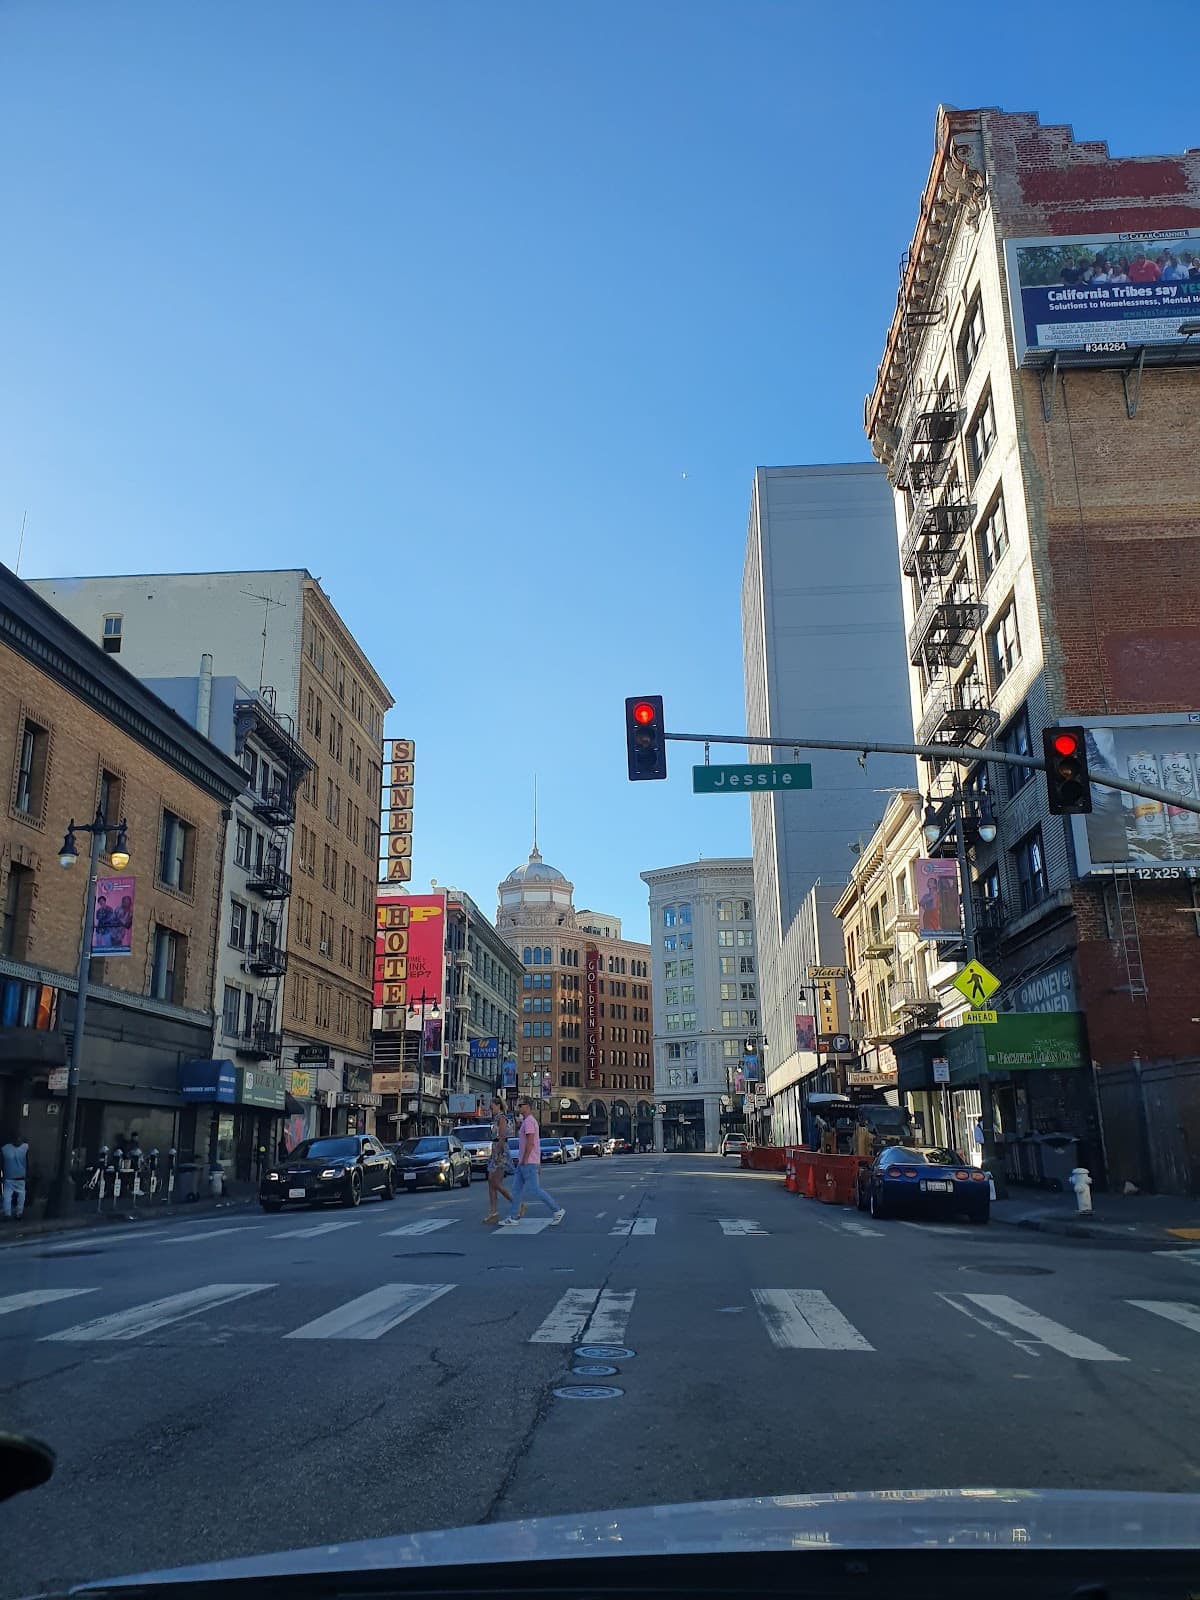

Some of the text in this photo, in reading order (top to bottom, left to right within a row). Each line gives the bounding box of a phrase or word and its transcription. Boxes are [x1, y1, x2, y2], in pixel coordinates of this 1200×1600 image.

[1048, 288, 1110, 301] California
[1112, 286, 1152, 297] Tribes
[1155, 286, 1177, 297] say
[1049, 302, 1088, 311] Solutions
[1100, 299, 1161, 309] Homelessness,
[1163, 296, 1191, 305] Mental
[714, 770, 792, 786] Jessie
[389, 742, 410, 879] SENECA
[385, 908, 407, 1031] HOTEL
[588, 961, 596, 1028] GOLDEN
[1027, 970, 1061, 1004] MONEY
[1028, 994, 1069, 1012] OANED
[967, 1013, 993, 1022] AHEAD
[320, 1091, 357, 1104] HTEL
